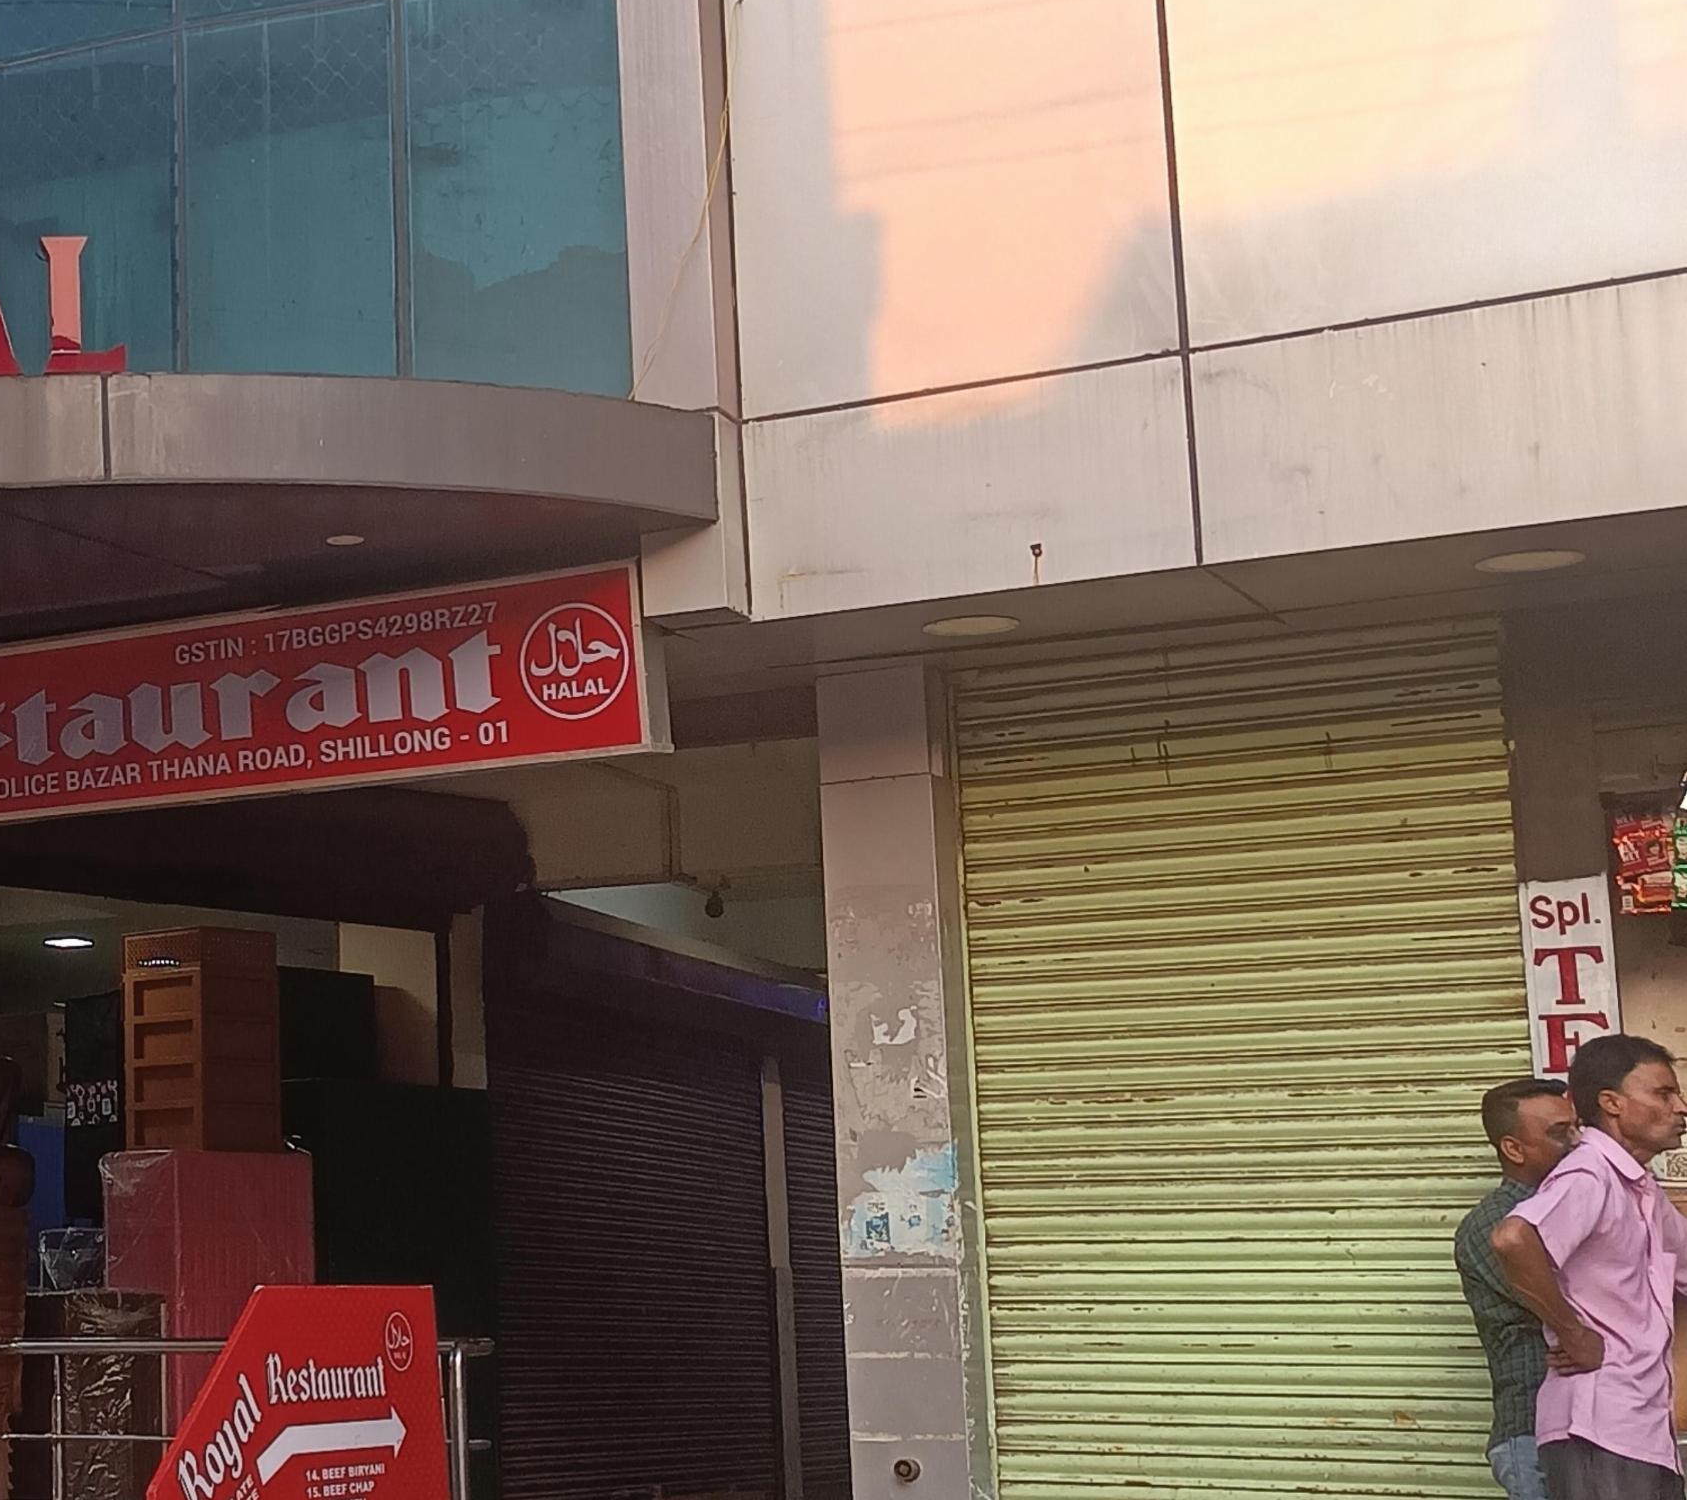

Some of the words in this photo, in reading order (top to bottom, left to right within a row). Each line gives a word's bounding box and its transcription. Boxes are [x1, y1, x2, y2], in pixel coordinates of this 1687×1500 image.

[175, 637, 243, 665] GSTIN
[264, 601, 498, 653] 17BGGPS4298RZ27
[530, 617, 620, 677] حلال
[542, 677, 611, 701] HALAL
[65, 764, 141, 791] BAZAR
[148, 752, 232, 783] THANA
[237, 744, 314, 771] ROAD,
[320, 727, 451, 763] SHILLONG
[478, 721, 509, 745] 01
[1529, 892, 1602, 935] Spl.
[265, 1353, 387, 1405] Restaurant
[306, 1470, 320, 1481] 14.
[322, 1467, 346, 1480] BEEF
[348, 1463, 385, 1477] BIRYANI
[307, 1487, 321, 1498] 15.
[323, 1484, 347, 1496] BEEF
[349, 1481, 375, 1493] CHAP
